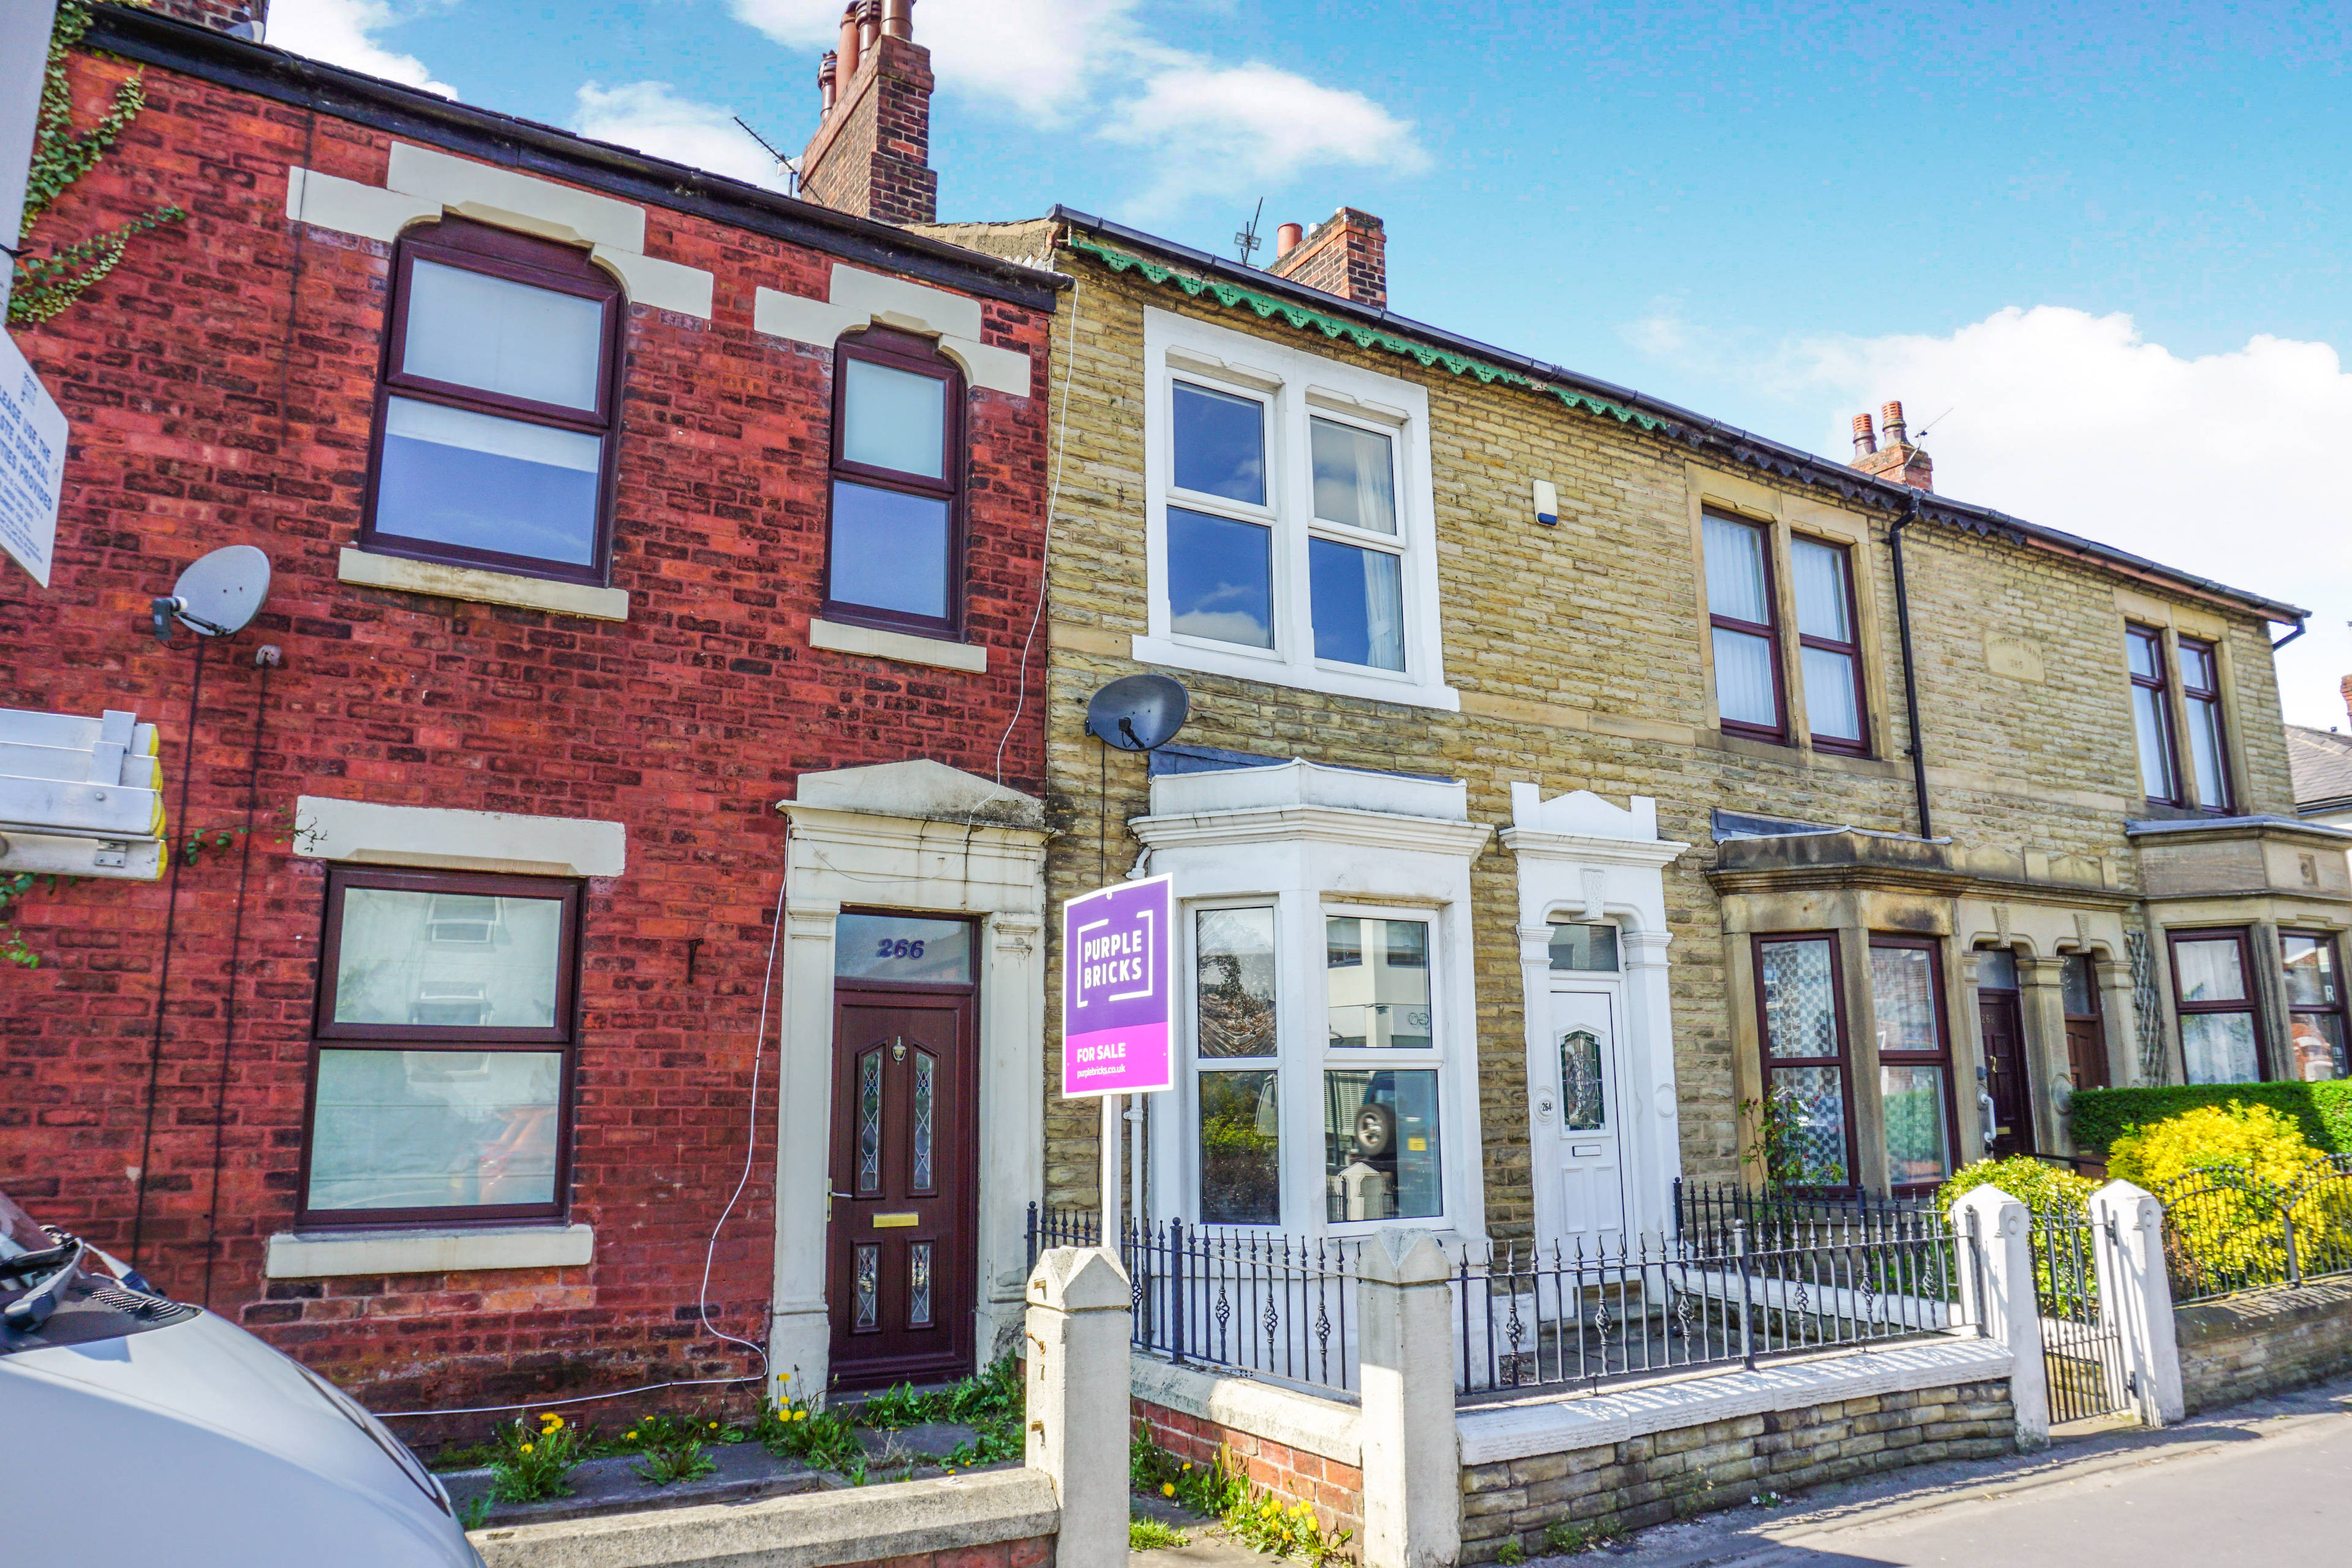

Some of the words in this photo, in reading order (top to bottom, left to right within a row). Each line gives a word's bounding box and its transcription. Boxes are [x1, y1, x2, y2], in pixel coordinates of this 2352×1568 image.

[23, 417, 37, 445] USE
[39, 437, 51, 464] THE
[16, 434, 48, 485] DISPOSAL
[19, 462, 52, 511] PROVIDED
[876, 938, 924, 959] 266
[1085, 930, 1142, 963] PURPLE
[1084, 957, 1142, 989] BRICKS
[1077, 1047, 1095, 1063] FOR
[1097, 1042, 1126, 1060] SALE
[1077, 1063, 1126, 1079] purplebricks.co.uk
[1542, 1102, 1551, 1112] 264
